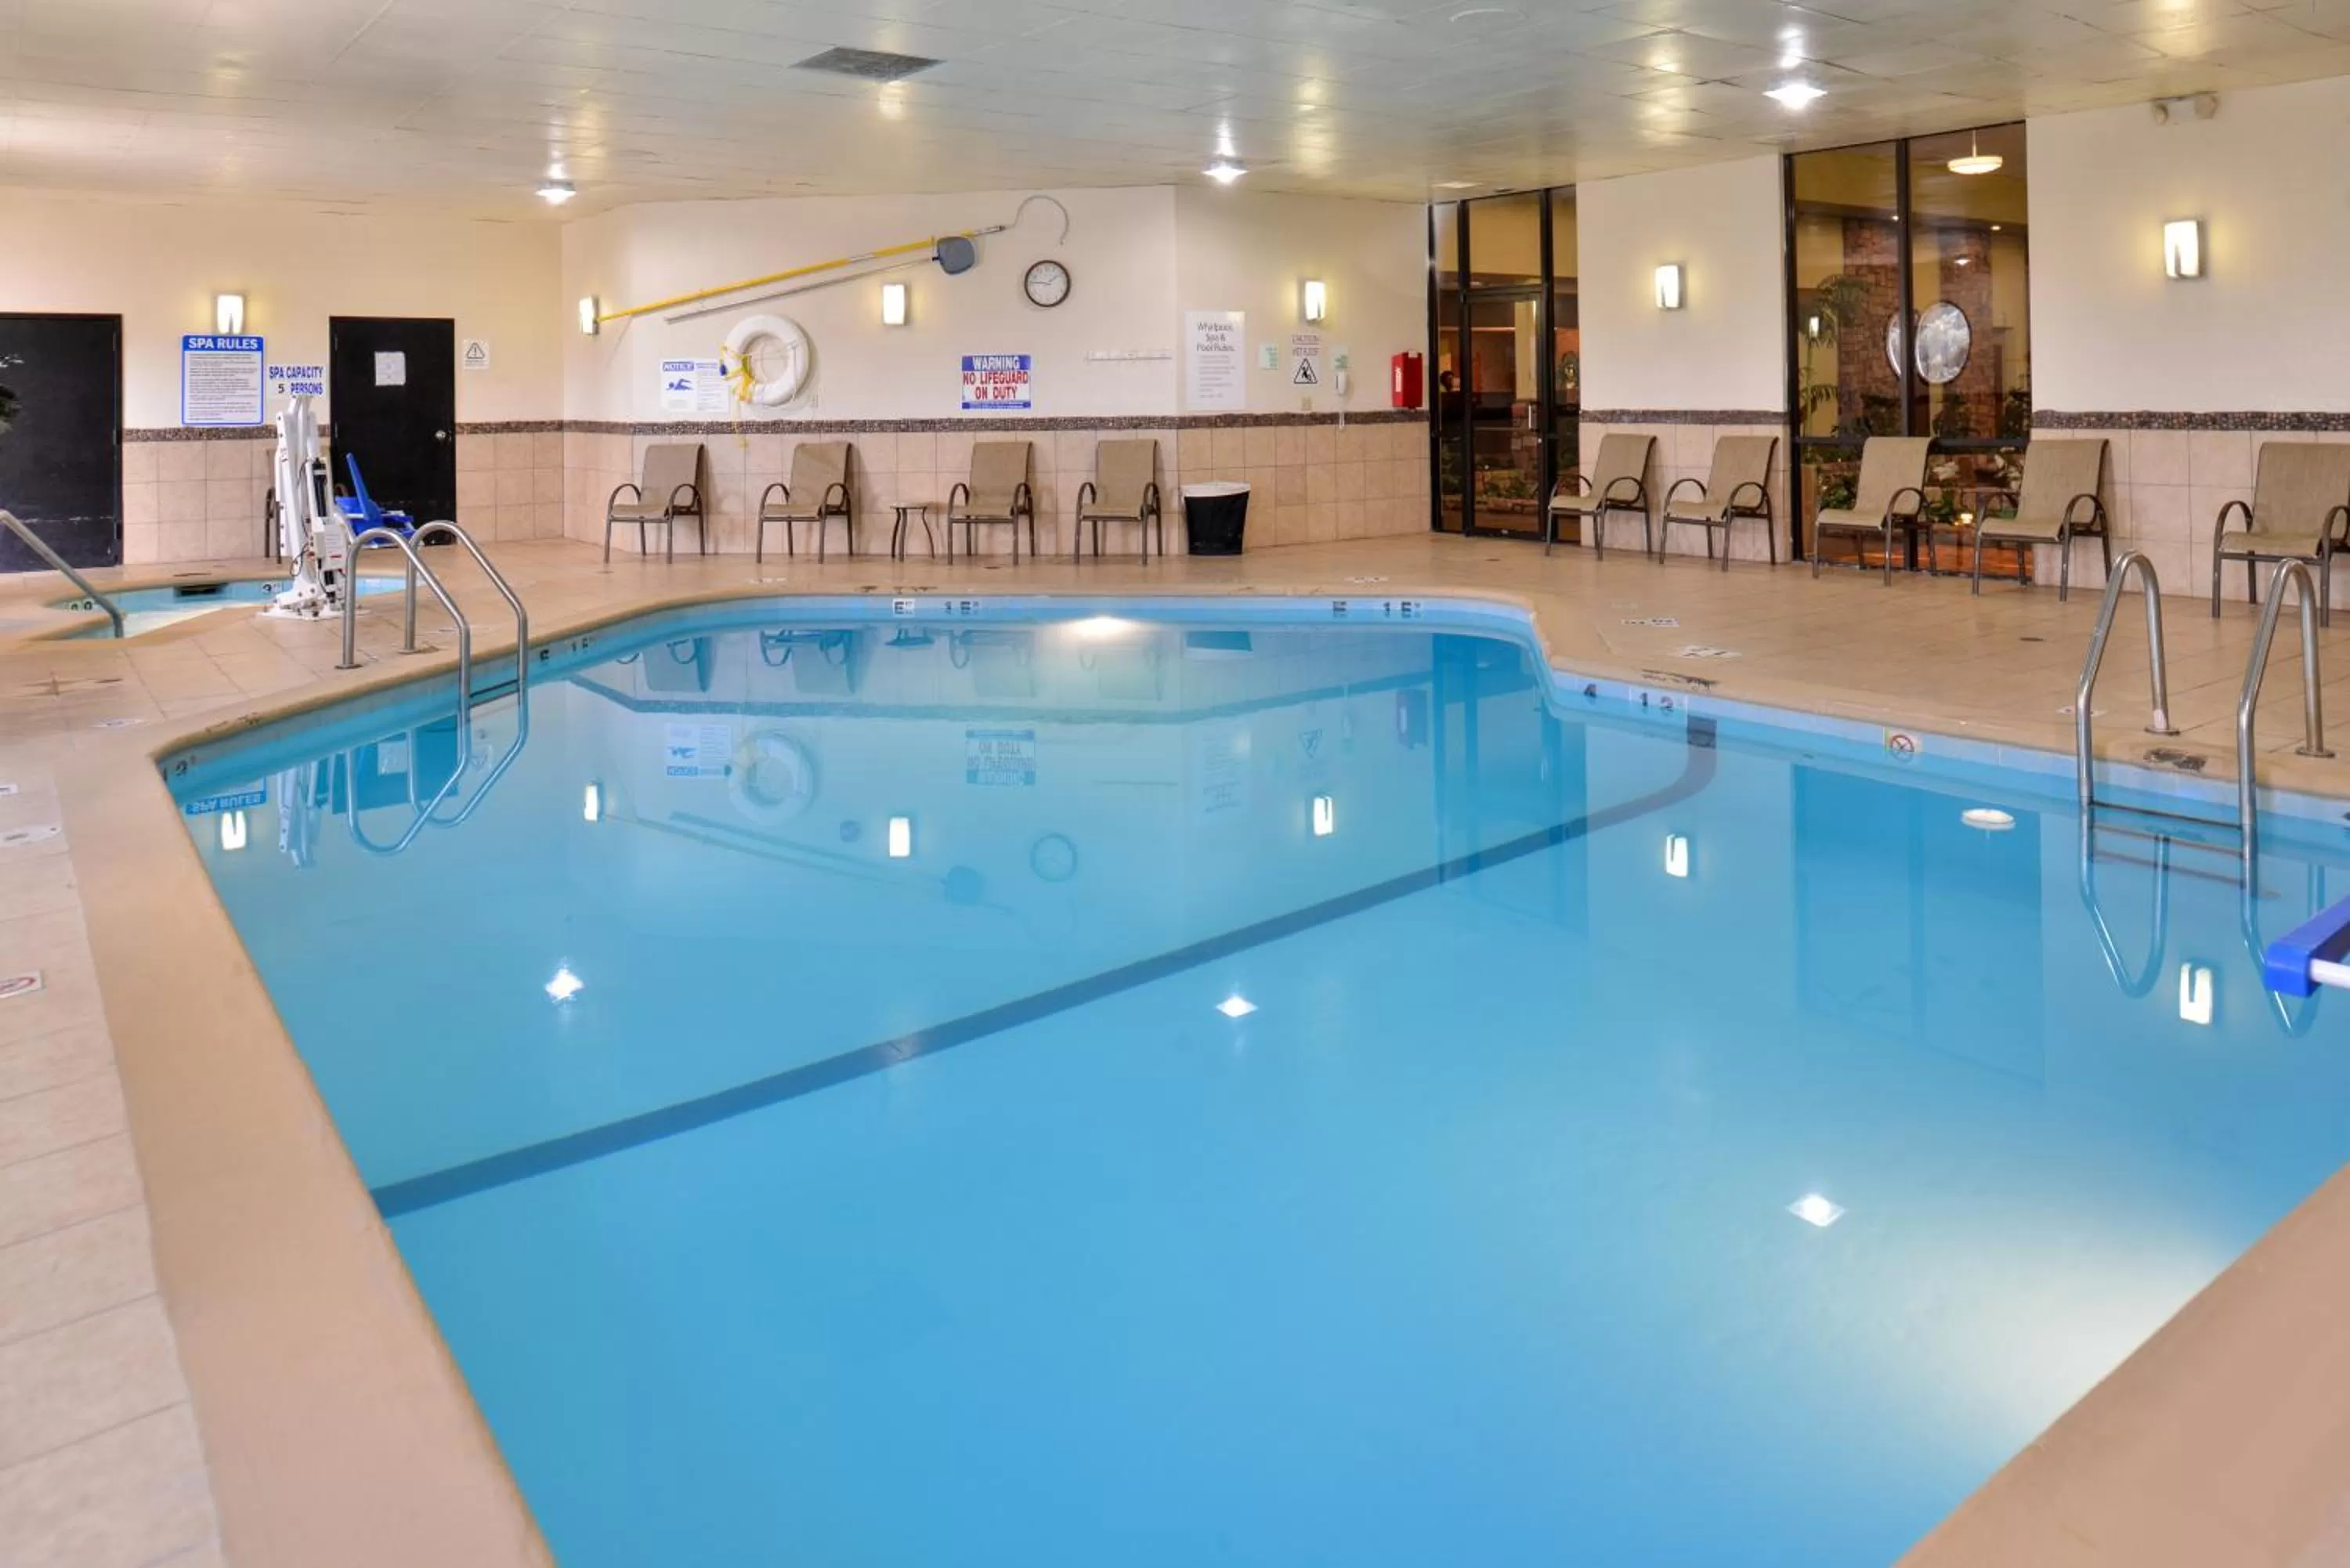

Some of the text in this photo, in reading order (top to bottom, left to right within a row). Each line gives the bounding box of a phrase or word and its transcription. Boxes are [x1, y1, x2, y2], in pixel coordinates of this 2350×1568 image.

[188, 338, 258, 349] SPA RULES
[973, 356, 1018, 369] WARNING
[269, 366, 323, 379] SPA CAPACITY
[963, 371, 1028, 385] NO LIFEGUARD
[278, 383, 323, 395] 5 PERSONS
[975, 386, 1018, 399] ON DUTY
